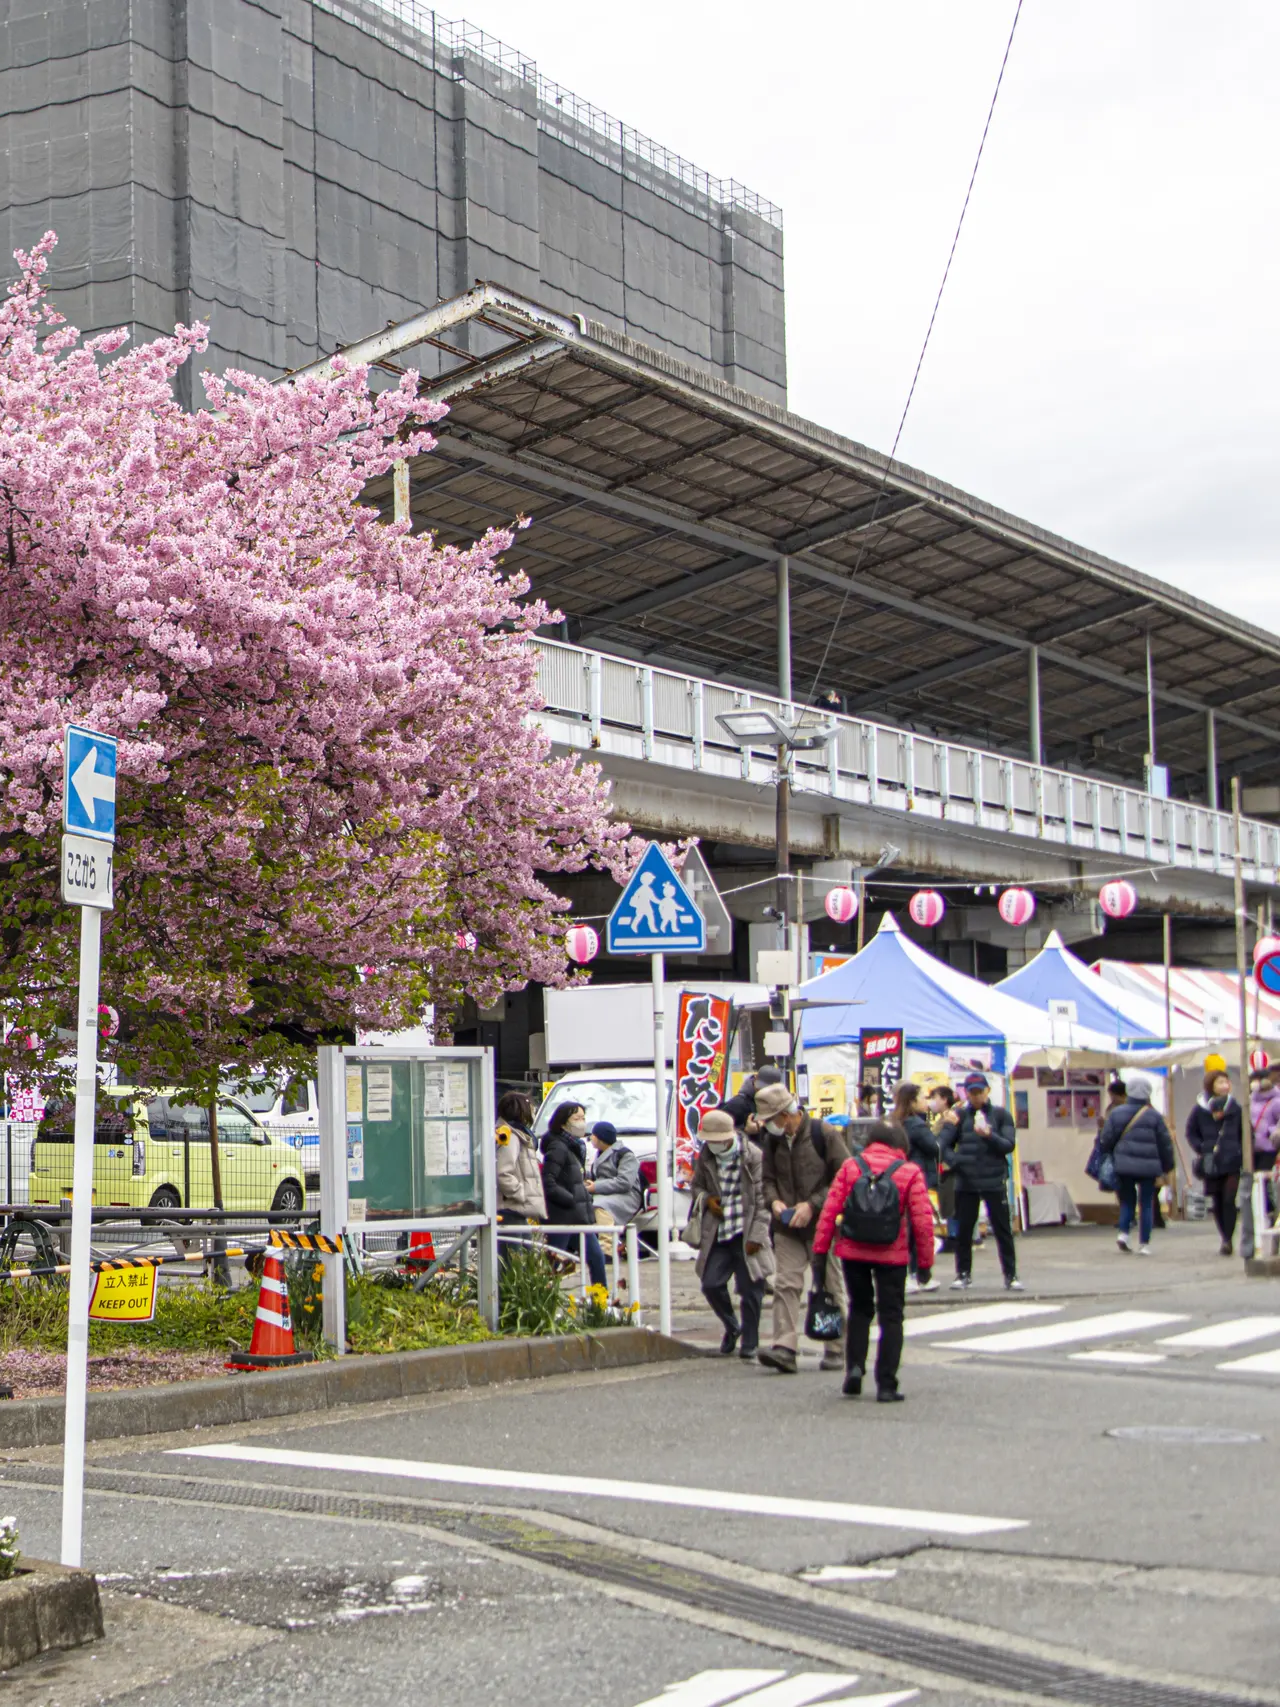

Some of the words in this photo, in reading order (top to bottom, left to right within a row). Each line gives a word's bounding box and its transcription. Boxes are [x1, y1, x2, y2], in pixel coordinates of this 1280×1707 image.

[66, 852, 96, 889] ここから
[103, 1272, 149, 1289] 立入禁止
[98, 1299, 126, 1309] KEEP
[128, 1297, 149, 1309] OUT
